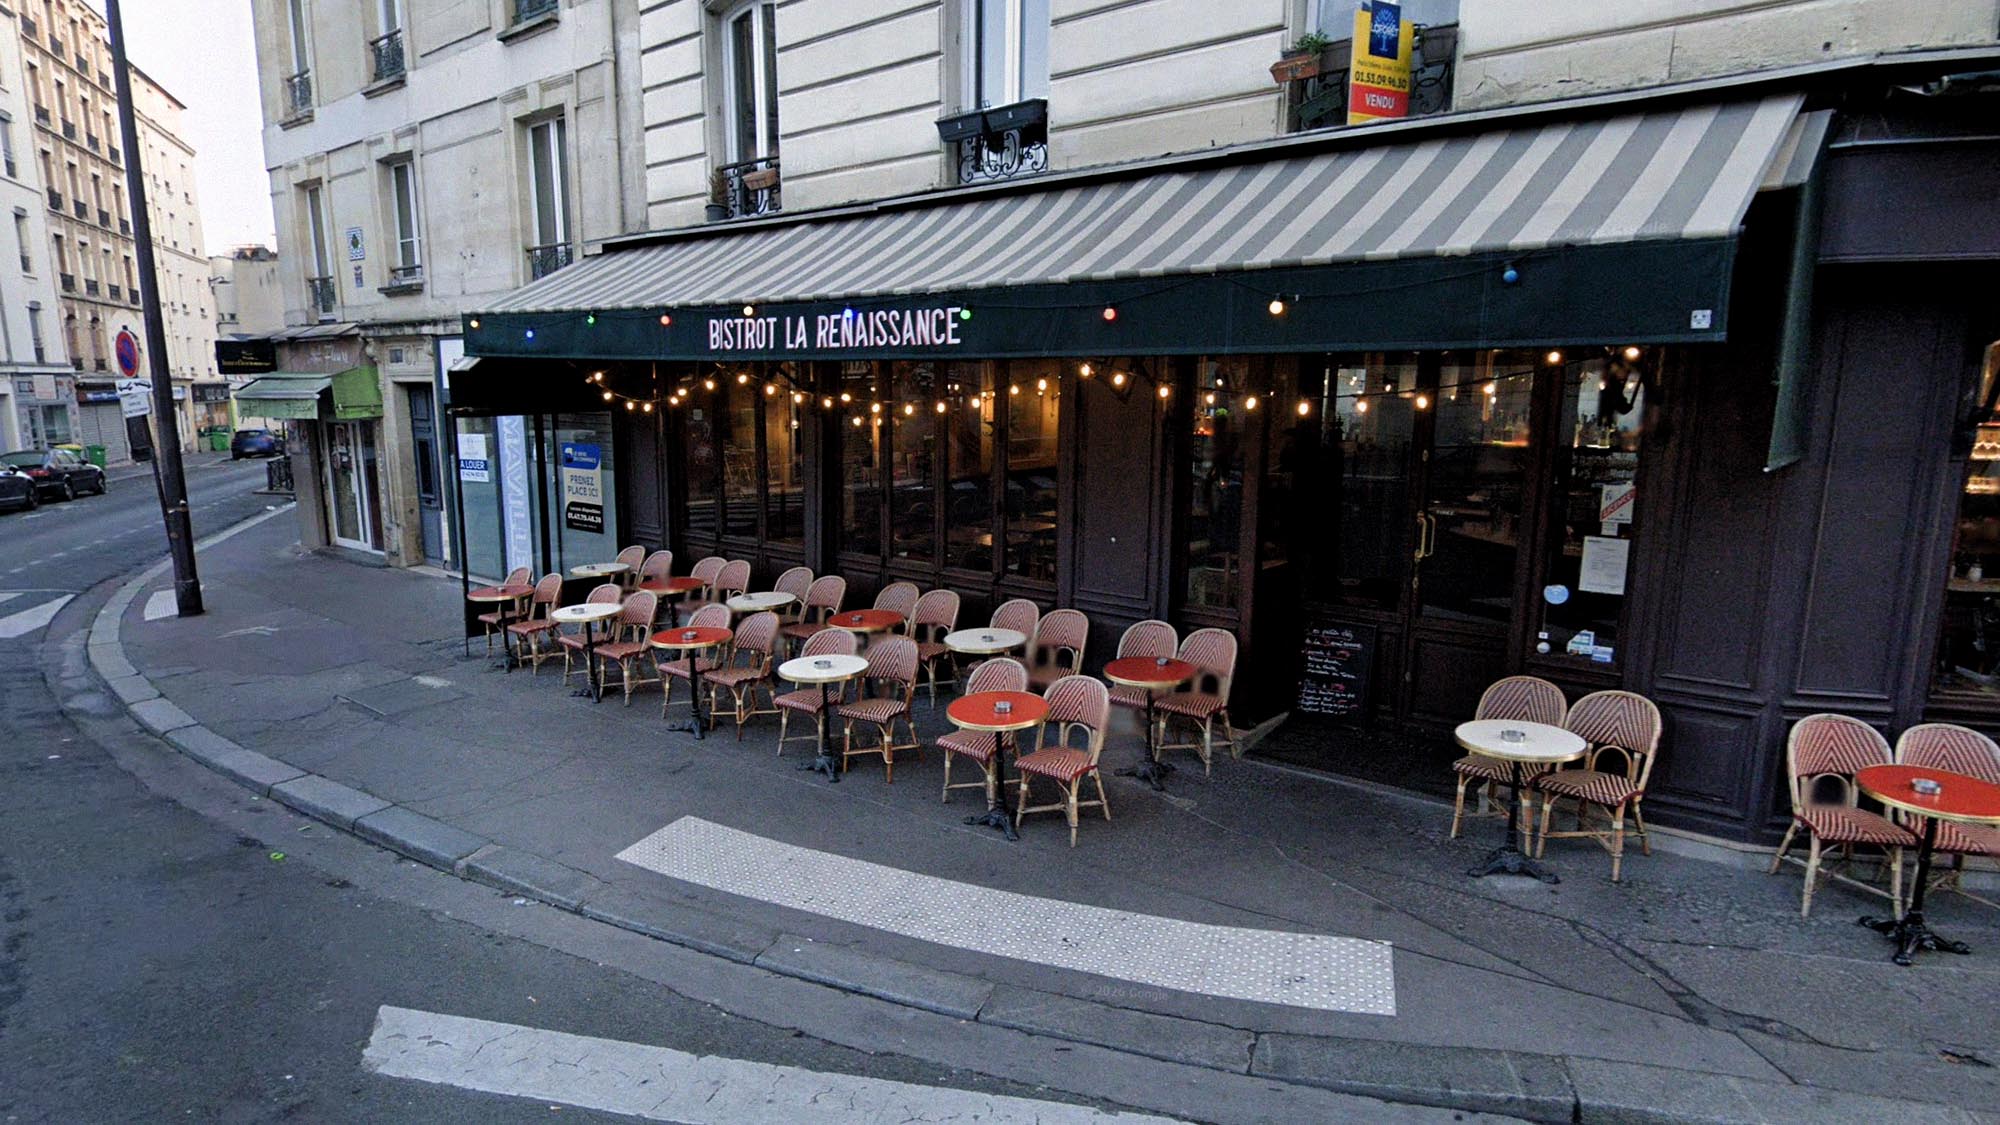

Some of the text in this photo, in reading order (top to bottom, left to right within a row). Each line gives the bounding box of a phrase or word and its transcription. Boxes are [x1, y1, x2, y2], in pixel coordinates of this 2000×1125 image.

[1365, 93, 1394, 109] VENDU
[709, 307, 961, 350] BISTROT LA RENAISSANCE
[465, 461, 485, 470] LOUER
[570, 474, 595, 486] PRENEZ
[567, 485, 588, 496] PLACE
